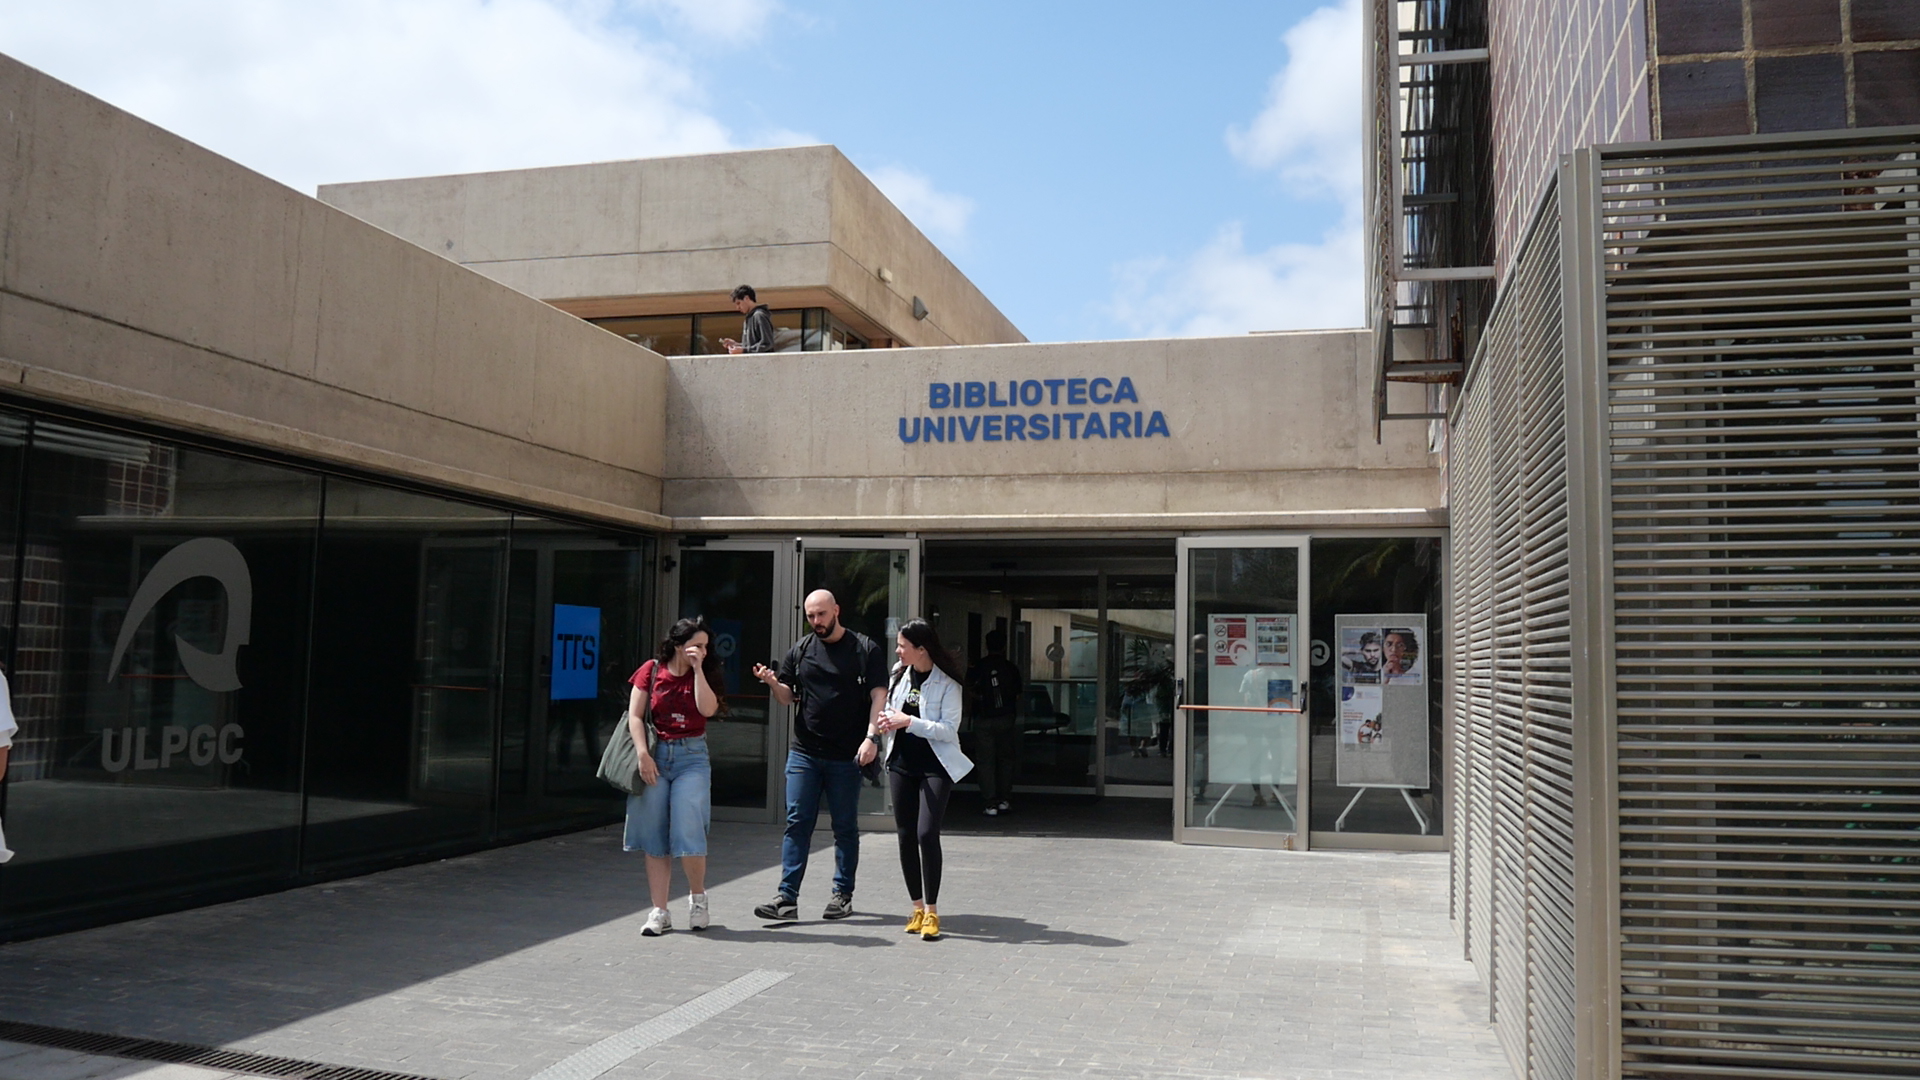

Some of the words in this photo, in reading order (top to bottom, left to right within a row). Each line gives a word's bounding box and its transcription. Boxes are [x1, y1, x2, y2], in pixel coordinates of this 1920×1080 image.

[929, 377, 1138, 408] BIBLIOTECA
[899, 411, 1170, 443] UNIVERSITARIA
[557, 633, 595, 670] TTS
[101, 723, 244, 772] ULPGC
